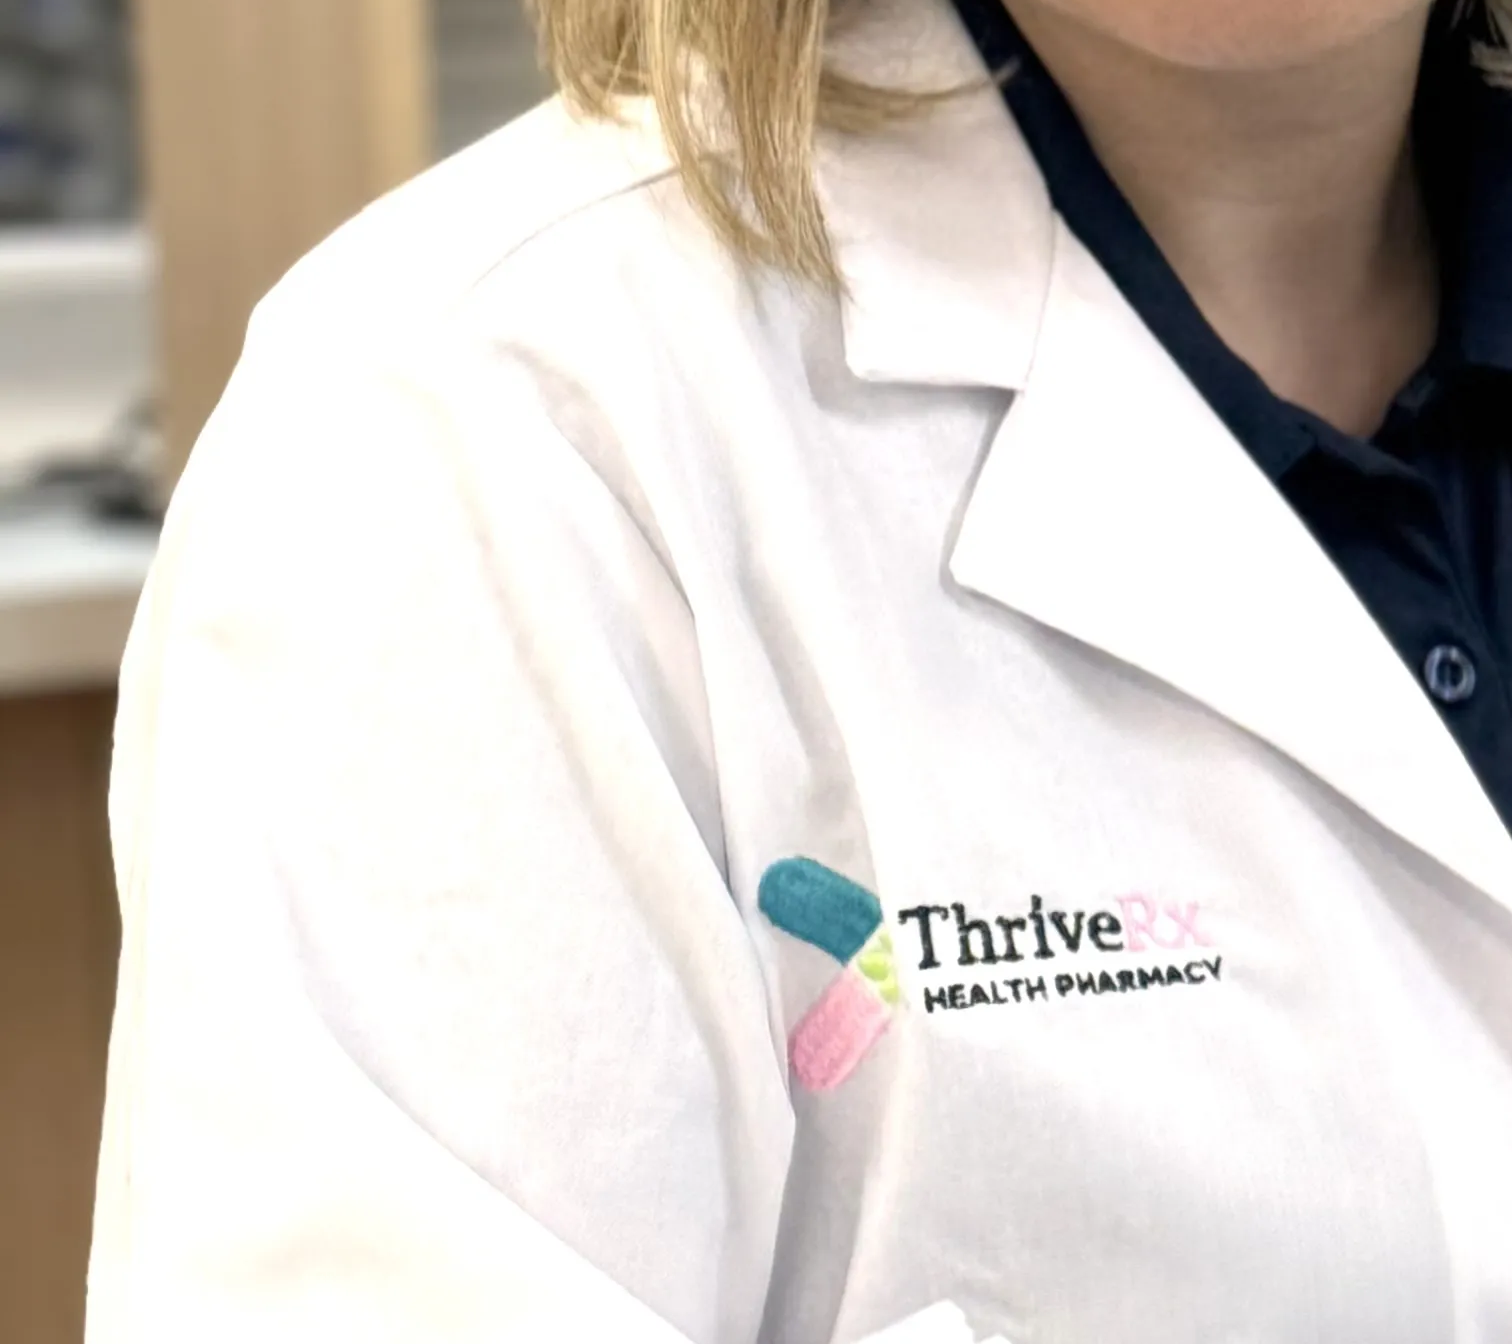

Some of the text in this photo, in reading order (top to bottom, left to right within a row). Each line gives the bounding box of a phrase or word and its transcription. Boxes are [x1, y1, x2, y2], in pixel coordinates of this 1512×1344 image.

[899, 891, 1216, 970] ThriveRx
[923, 956, 1223, 1013] HEALTH PHARMACY
